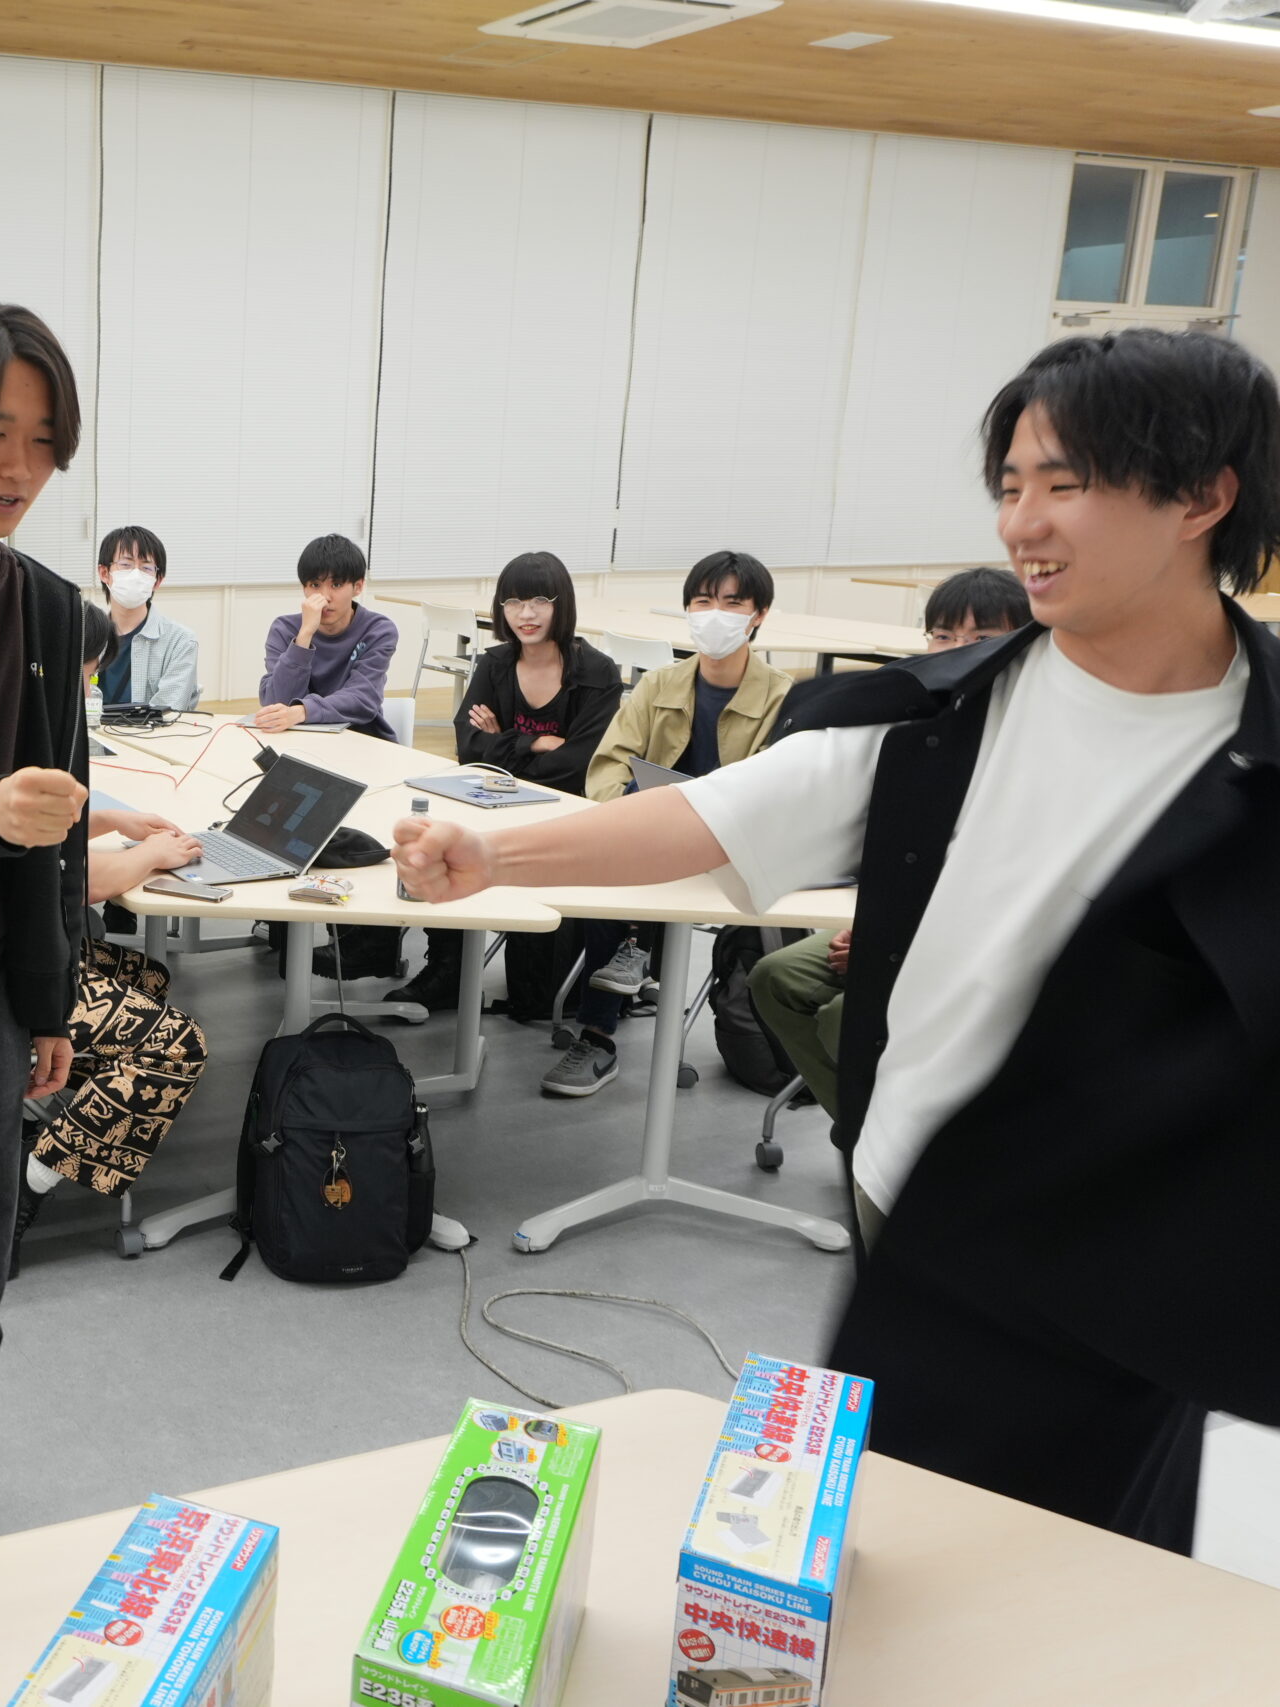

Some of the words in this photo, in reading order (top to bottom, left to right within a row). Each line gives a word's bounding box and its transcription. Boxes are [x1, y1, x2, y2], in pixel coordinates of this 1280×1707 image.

[761, 1366, 811, 1445] 中央快速線
[812, 1372, 838, 1425] サウンドトレイン
[804, 1425, 825, 1456] E233系
[845, 1438, 856, 1456] SOUND
[825, 1458, 842, 1490] KAISOKU
[821, 1489, 835, 1507] LINE
[118, 1507, 211, 1619] 京浜東北線
[186, 1518, 240, 1591] サウンドトレイン
[233, 1528, 264, 1570] リアルサウンド
[693, 1563, 724, 1578] SOUND
[726, 1573, 752, 1587] TRAIN
[754, 1583, 785, 1598] SERIES
[787, 1593, 809, 1605] E233
[734, 1582, 784, 1604] KAISOKU
[786, 1601, 813, 1614] LINE
[159, 1591, 196, 1635] E233系
[522, 1594, 536, 1611] LINE
[684, 1583, 762, 1614] サウンドトレイン
[764, 1608, 807, 1629] E233系
[188, 1606, 215, 1640] KEIHIN
[204, 1609, 225, 1637] SOUND
[683, 1601, 816, 1661] 中央快速線
[164, 1640, 196, 1682] TOHOKU
[190, 1636, 211, 1661] TRAIN
[173, 1660, 197, 1689] SERIES
[361, 1665, 430, 1694] サウンドトレイン
[150, 1682, 172, 1707] LINE
